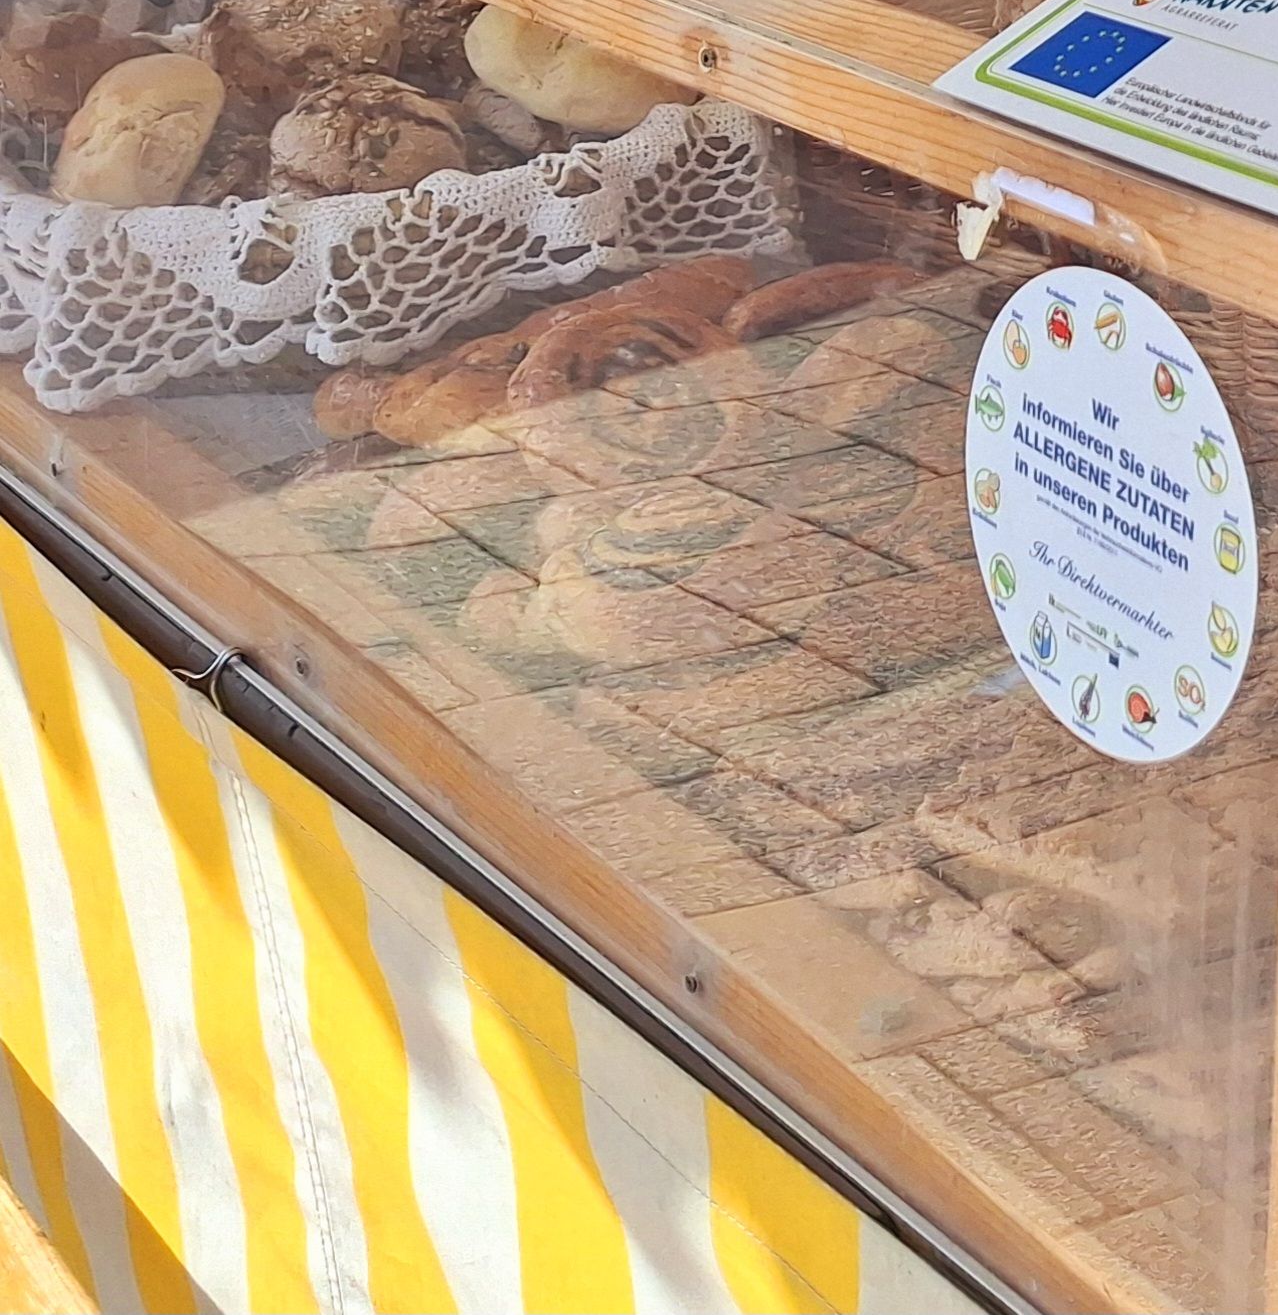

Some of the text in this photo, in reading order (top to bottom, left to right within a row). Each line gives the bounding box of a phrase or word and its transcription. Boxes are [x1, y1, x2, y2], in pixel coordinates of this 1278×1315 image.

[1160, 3, 1239, 30] AGRARREFERAT
[1022, 390, 1190, 507] informieren Sie über
[1092, 397, 1119, 433] Wir
[1013, 417, 1110, 493] ALLERGENE
[1116, 476, 1194, 542] ZUTATEN
[1014, 451, 1028, 477] in
[1033, 465, 1096, 518] unseren
[1102, 502, 1188, 572] Produkten
